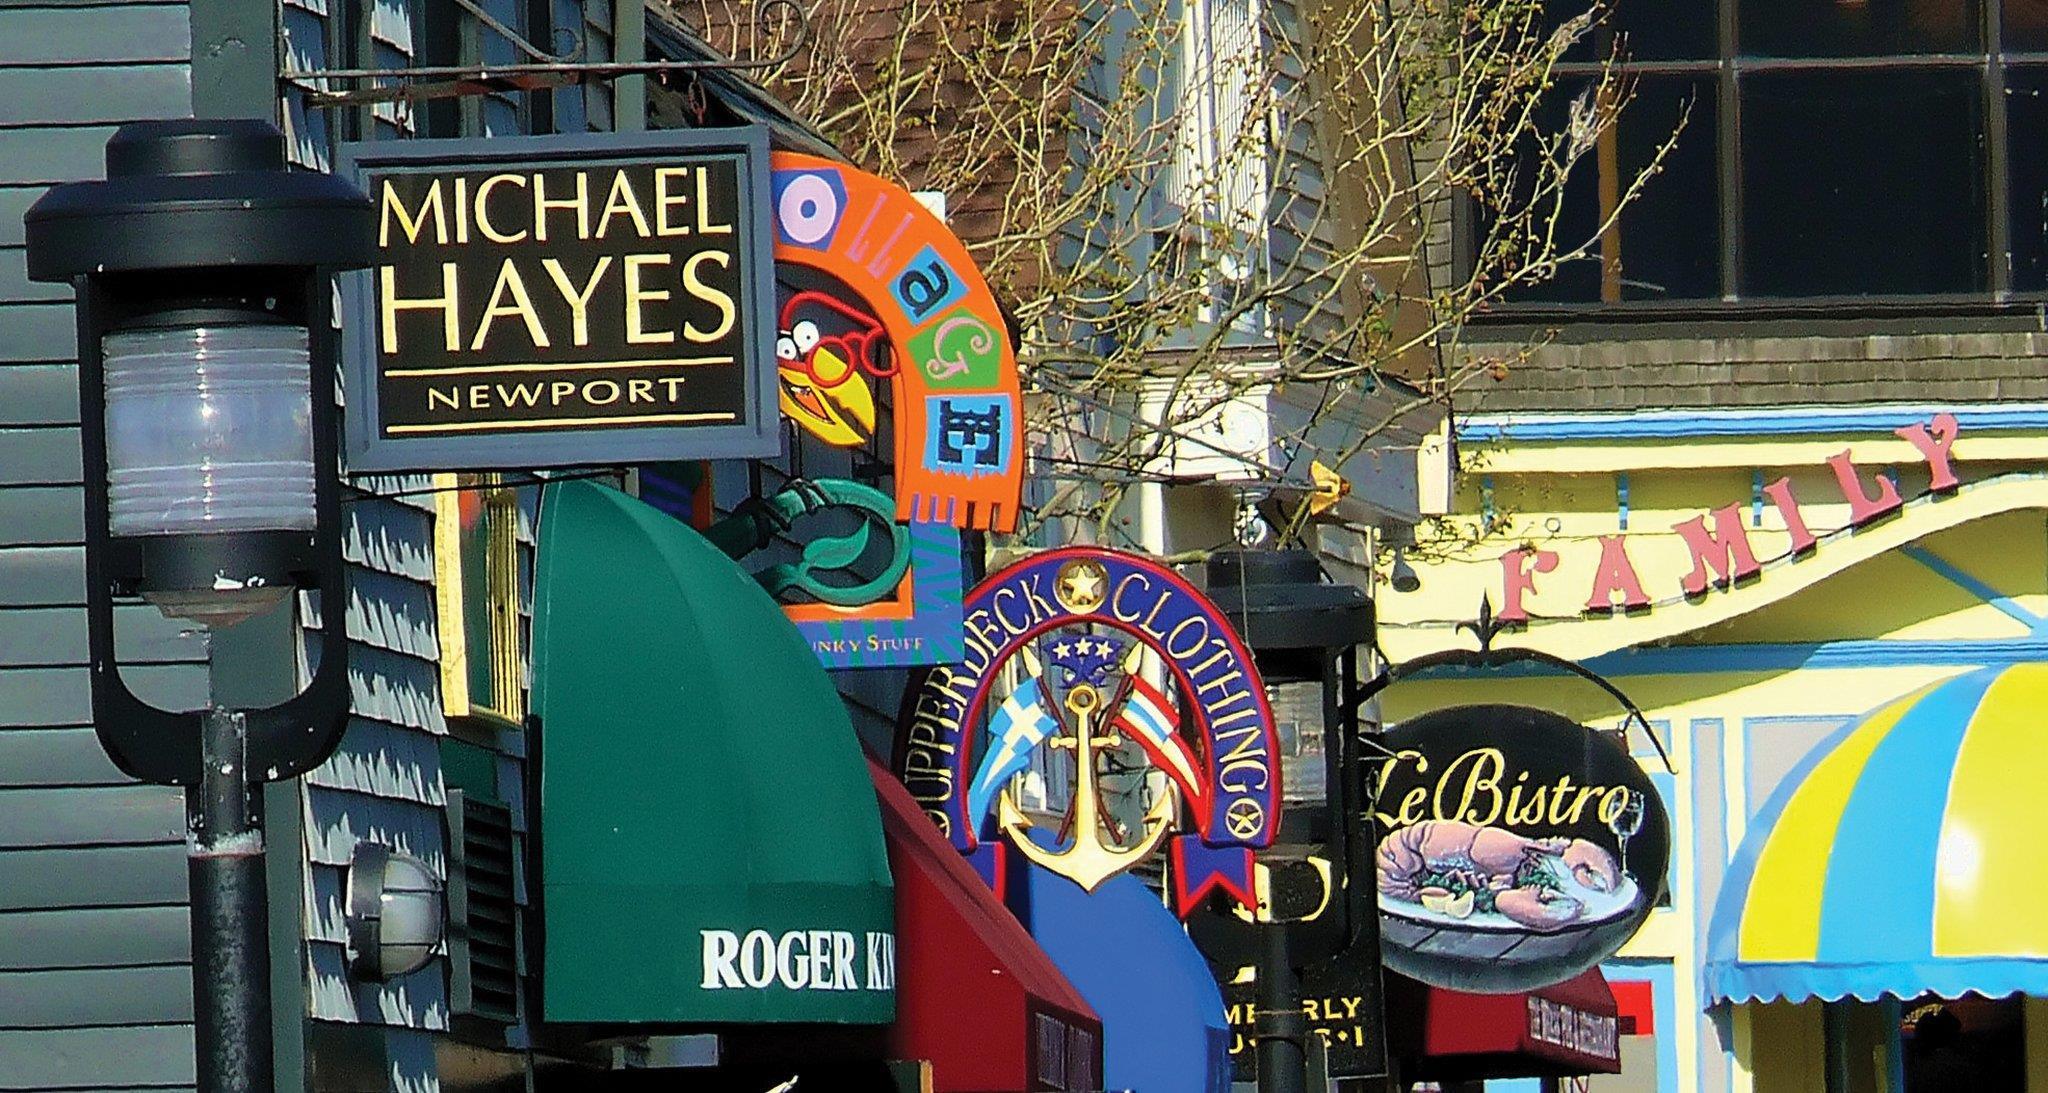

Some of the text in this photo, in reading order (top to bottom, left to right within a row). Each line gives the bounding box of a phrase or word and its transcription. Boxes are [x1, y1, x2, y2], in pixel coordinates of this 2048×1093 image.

[379, 166, 732, 247] MICHAEL
[381, 250, 736, 354] HAYES
[428, 377, 686, 410] NEWPORT
[1498, 412, 1959, 622] FAMILY
[1112, 573, 1268, 794] CLOTHING
[1374, 748, 1630, 829] Le Bistro
[700, 929, 858, 990] ROGER
